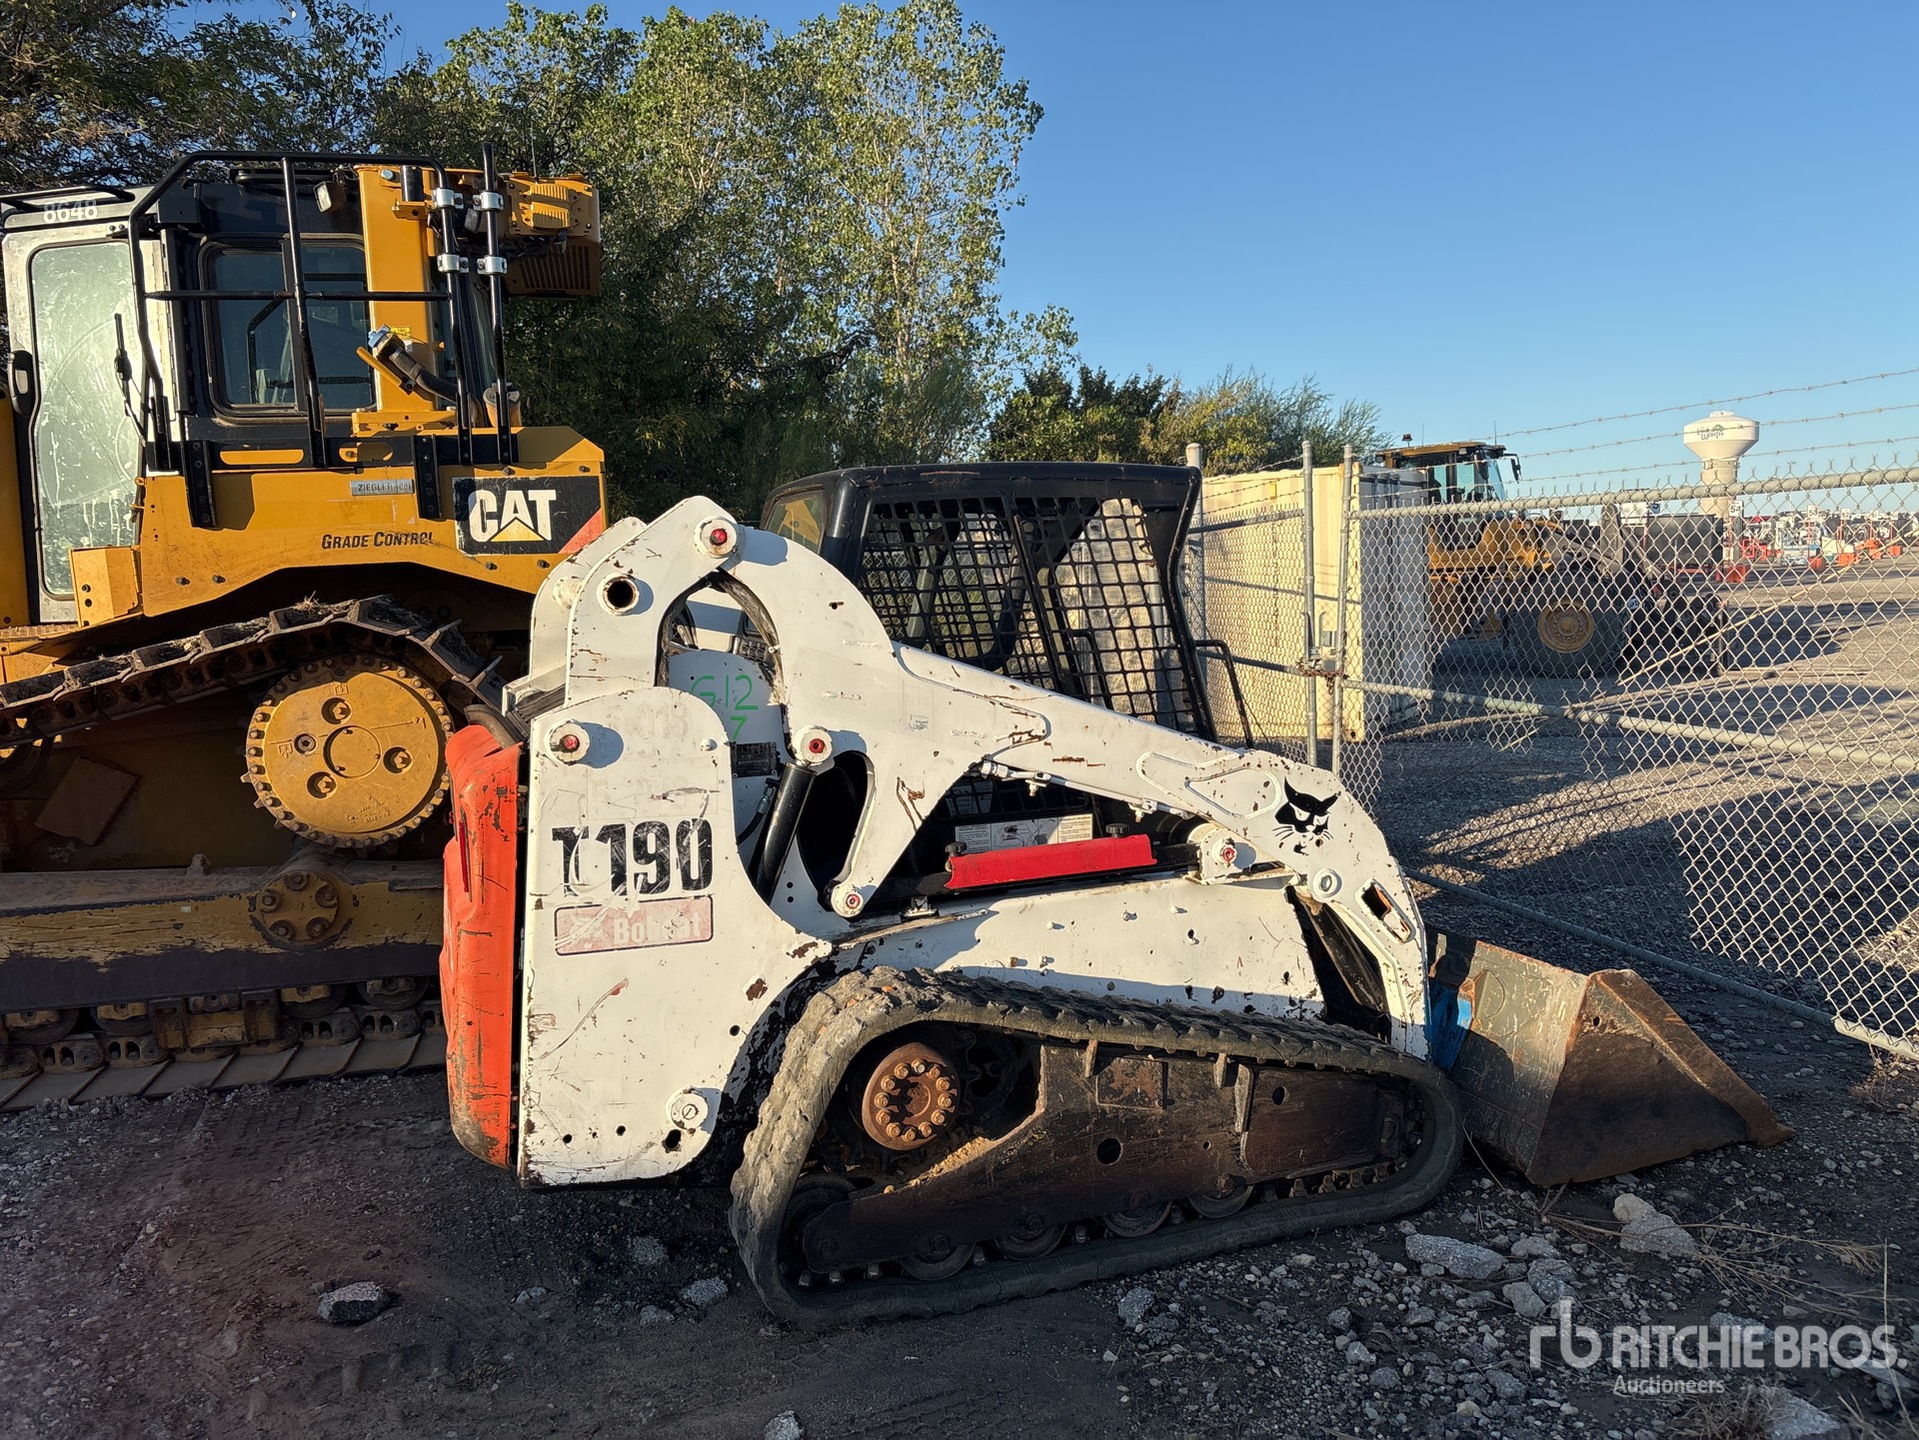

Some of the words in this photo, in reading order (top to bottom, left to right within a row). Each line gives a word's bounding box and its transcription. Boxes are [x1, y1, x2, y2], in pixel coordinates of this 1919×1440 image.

[467, 488, 557, 543] CAT
[1729, 505, 1741, 514] 54
[321, 533, 369, 550] GRADE
[373, 531, 433, 548] CONTROL
[730, 715, 748, 742] 7
[551, 817, 713, 897] T190
